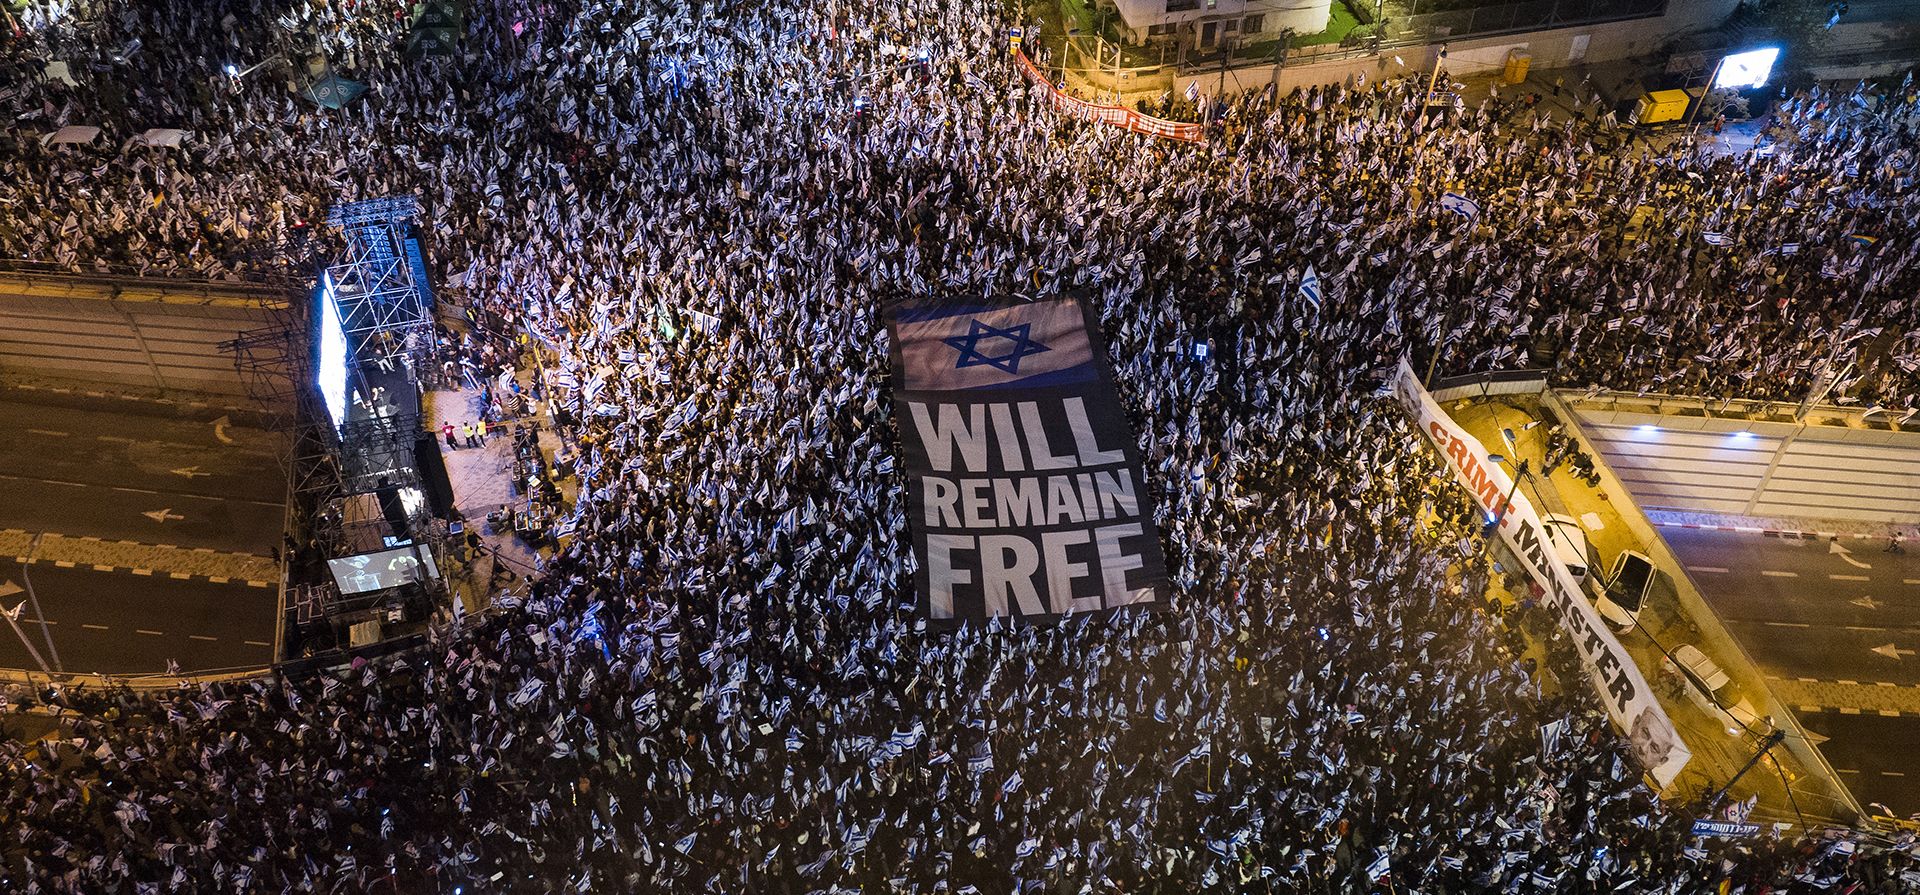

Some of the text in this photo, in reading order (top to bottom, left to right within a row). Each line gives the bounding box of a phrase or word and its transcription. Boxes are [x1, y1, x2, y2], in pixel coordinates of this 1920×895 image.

[908, 396, 1125, 472] WILL
[922, 470, 1140, 528] REMAIN
[926, 523, 1156, 619] FREE
[1429, 420, 1636, 714] CRIME MINISTER
